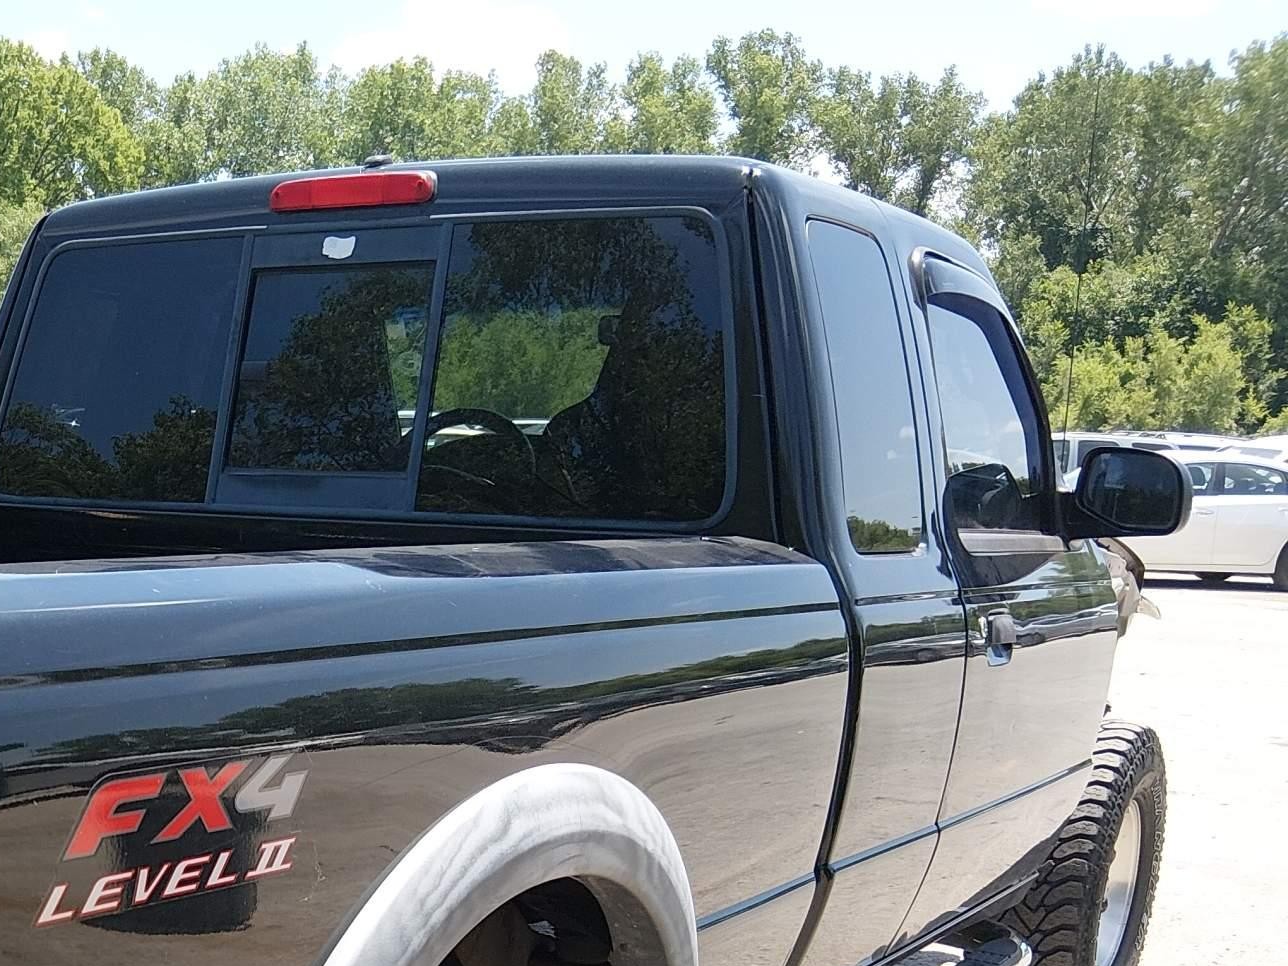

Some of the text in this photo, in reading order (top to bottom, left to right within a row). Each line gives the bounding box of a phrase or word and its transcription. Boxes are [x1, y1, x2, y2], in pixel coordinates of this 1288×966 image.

[62, 752, 309, 863] FX4
[34, 836, 297, 928] LEVEL II
